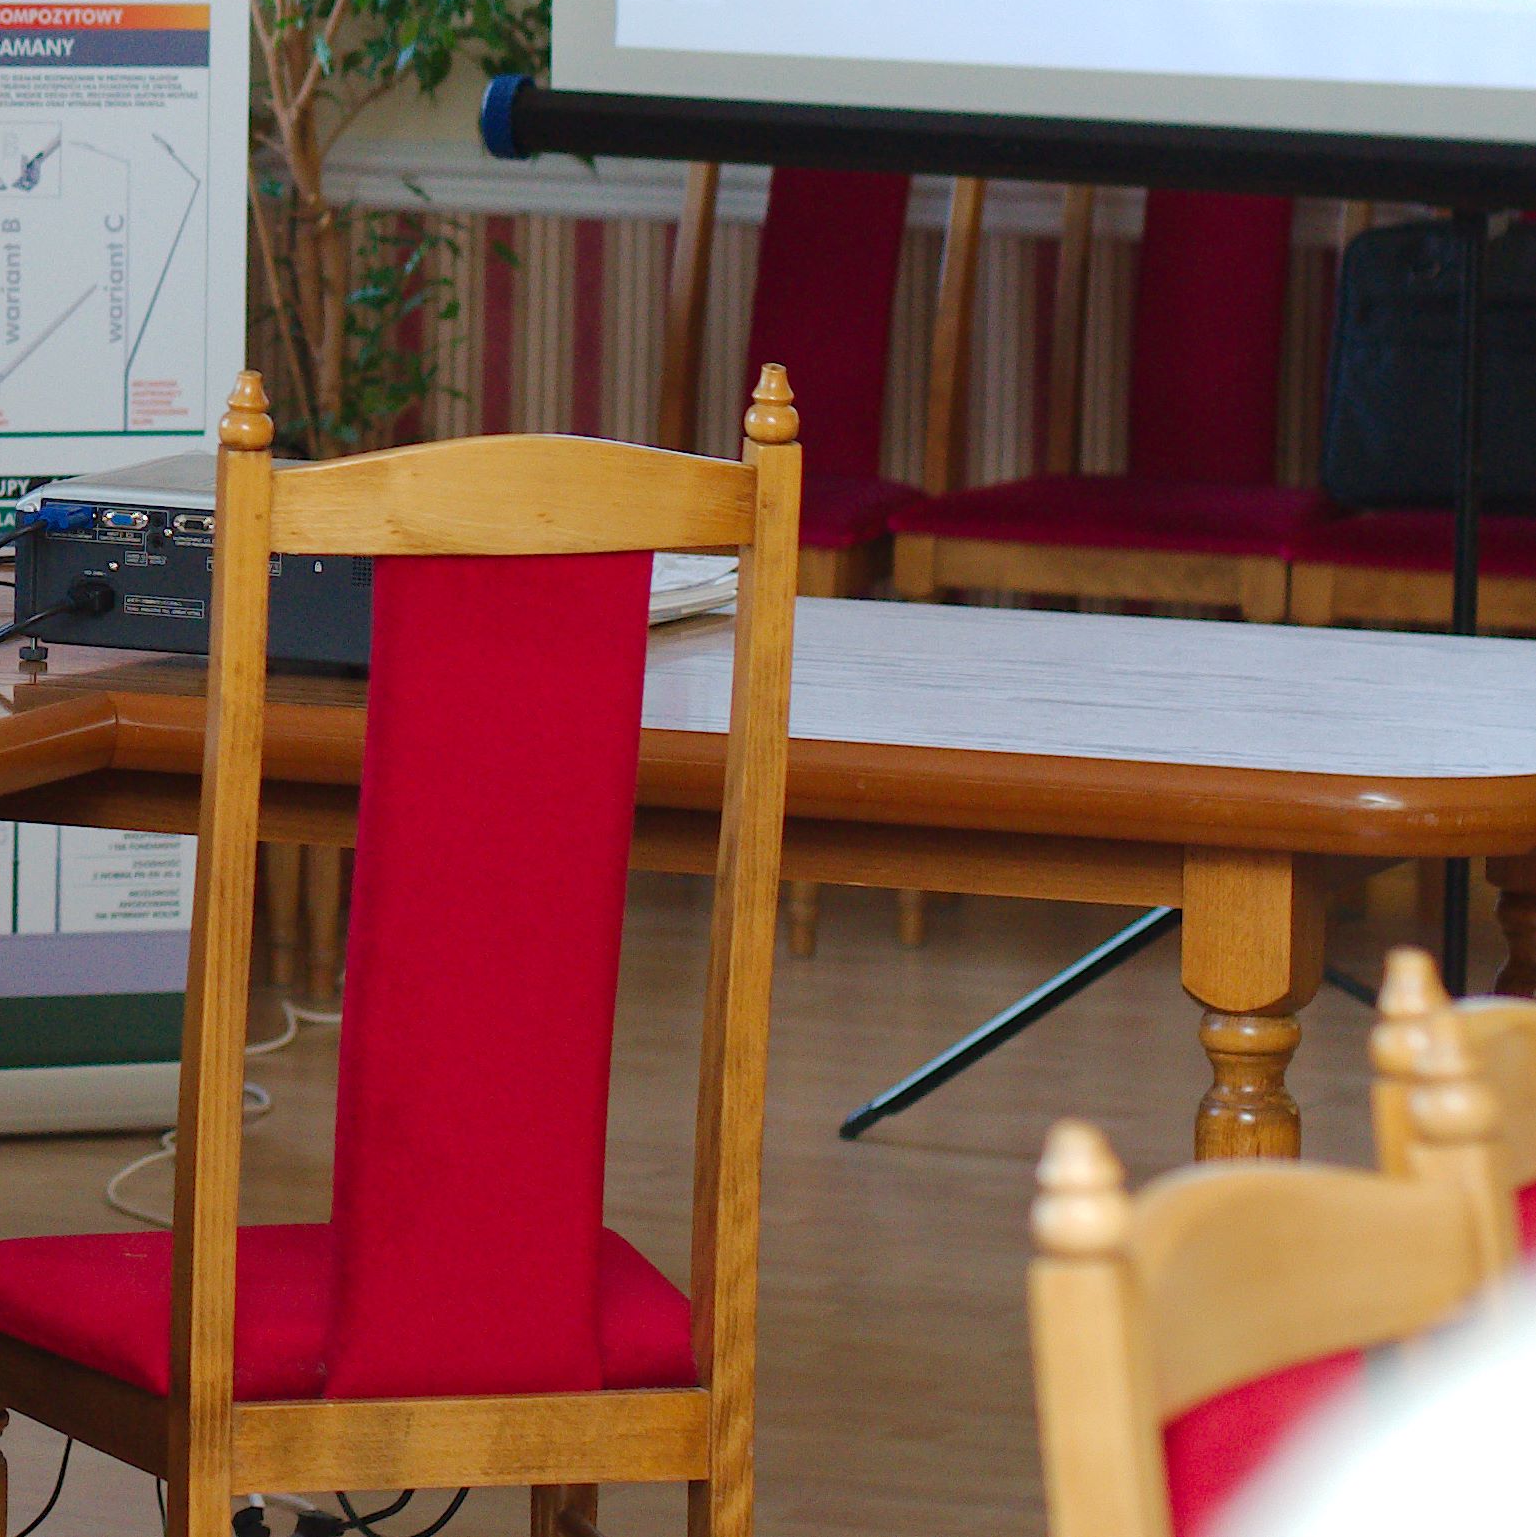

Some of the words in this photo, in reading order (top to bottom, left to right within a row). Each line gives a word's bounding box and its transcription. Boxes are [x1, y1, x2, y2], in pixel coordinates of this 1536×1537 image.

[2, 217, 22, 234] B
[104, 213, 125, 233] C
[0, 243, 21, 346] wariant
[103, 242, 124, 344] wariant
